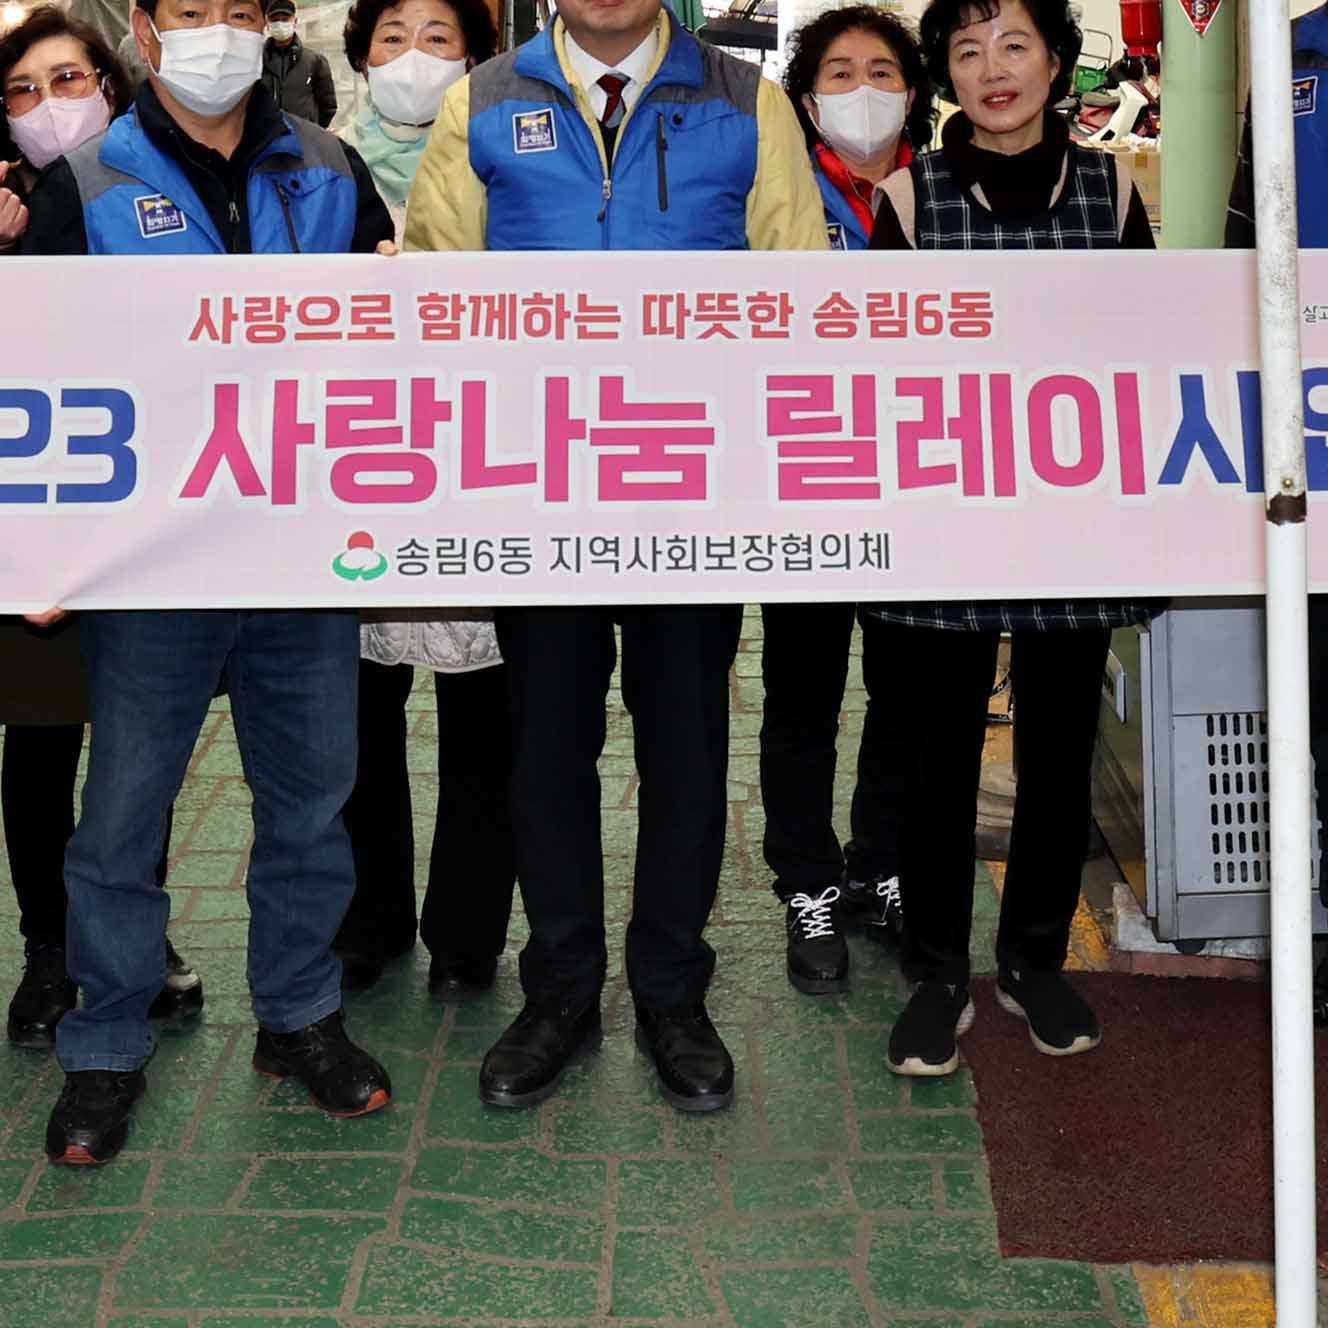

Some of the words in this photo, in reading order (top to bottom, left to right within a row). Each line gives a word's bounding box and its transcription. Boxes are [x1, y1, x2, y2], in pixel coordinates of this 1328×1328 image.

[188, 294, 395, 344] 사랑으로
[416, 292, 622, 341] 함께하는
[643, 291, 794, 340] 따뜻한
[812, 290, 994, 339] 송림6동
[179, 372, 716, 505] 사랑나눔
[395, 535, 533, 576] 송림6동
[549, 532, 891, 575] 지역사회보장협의체
